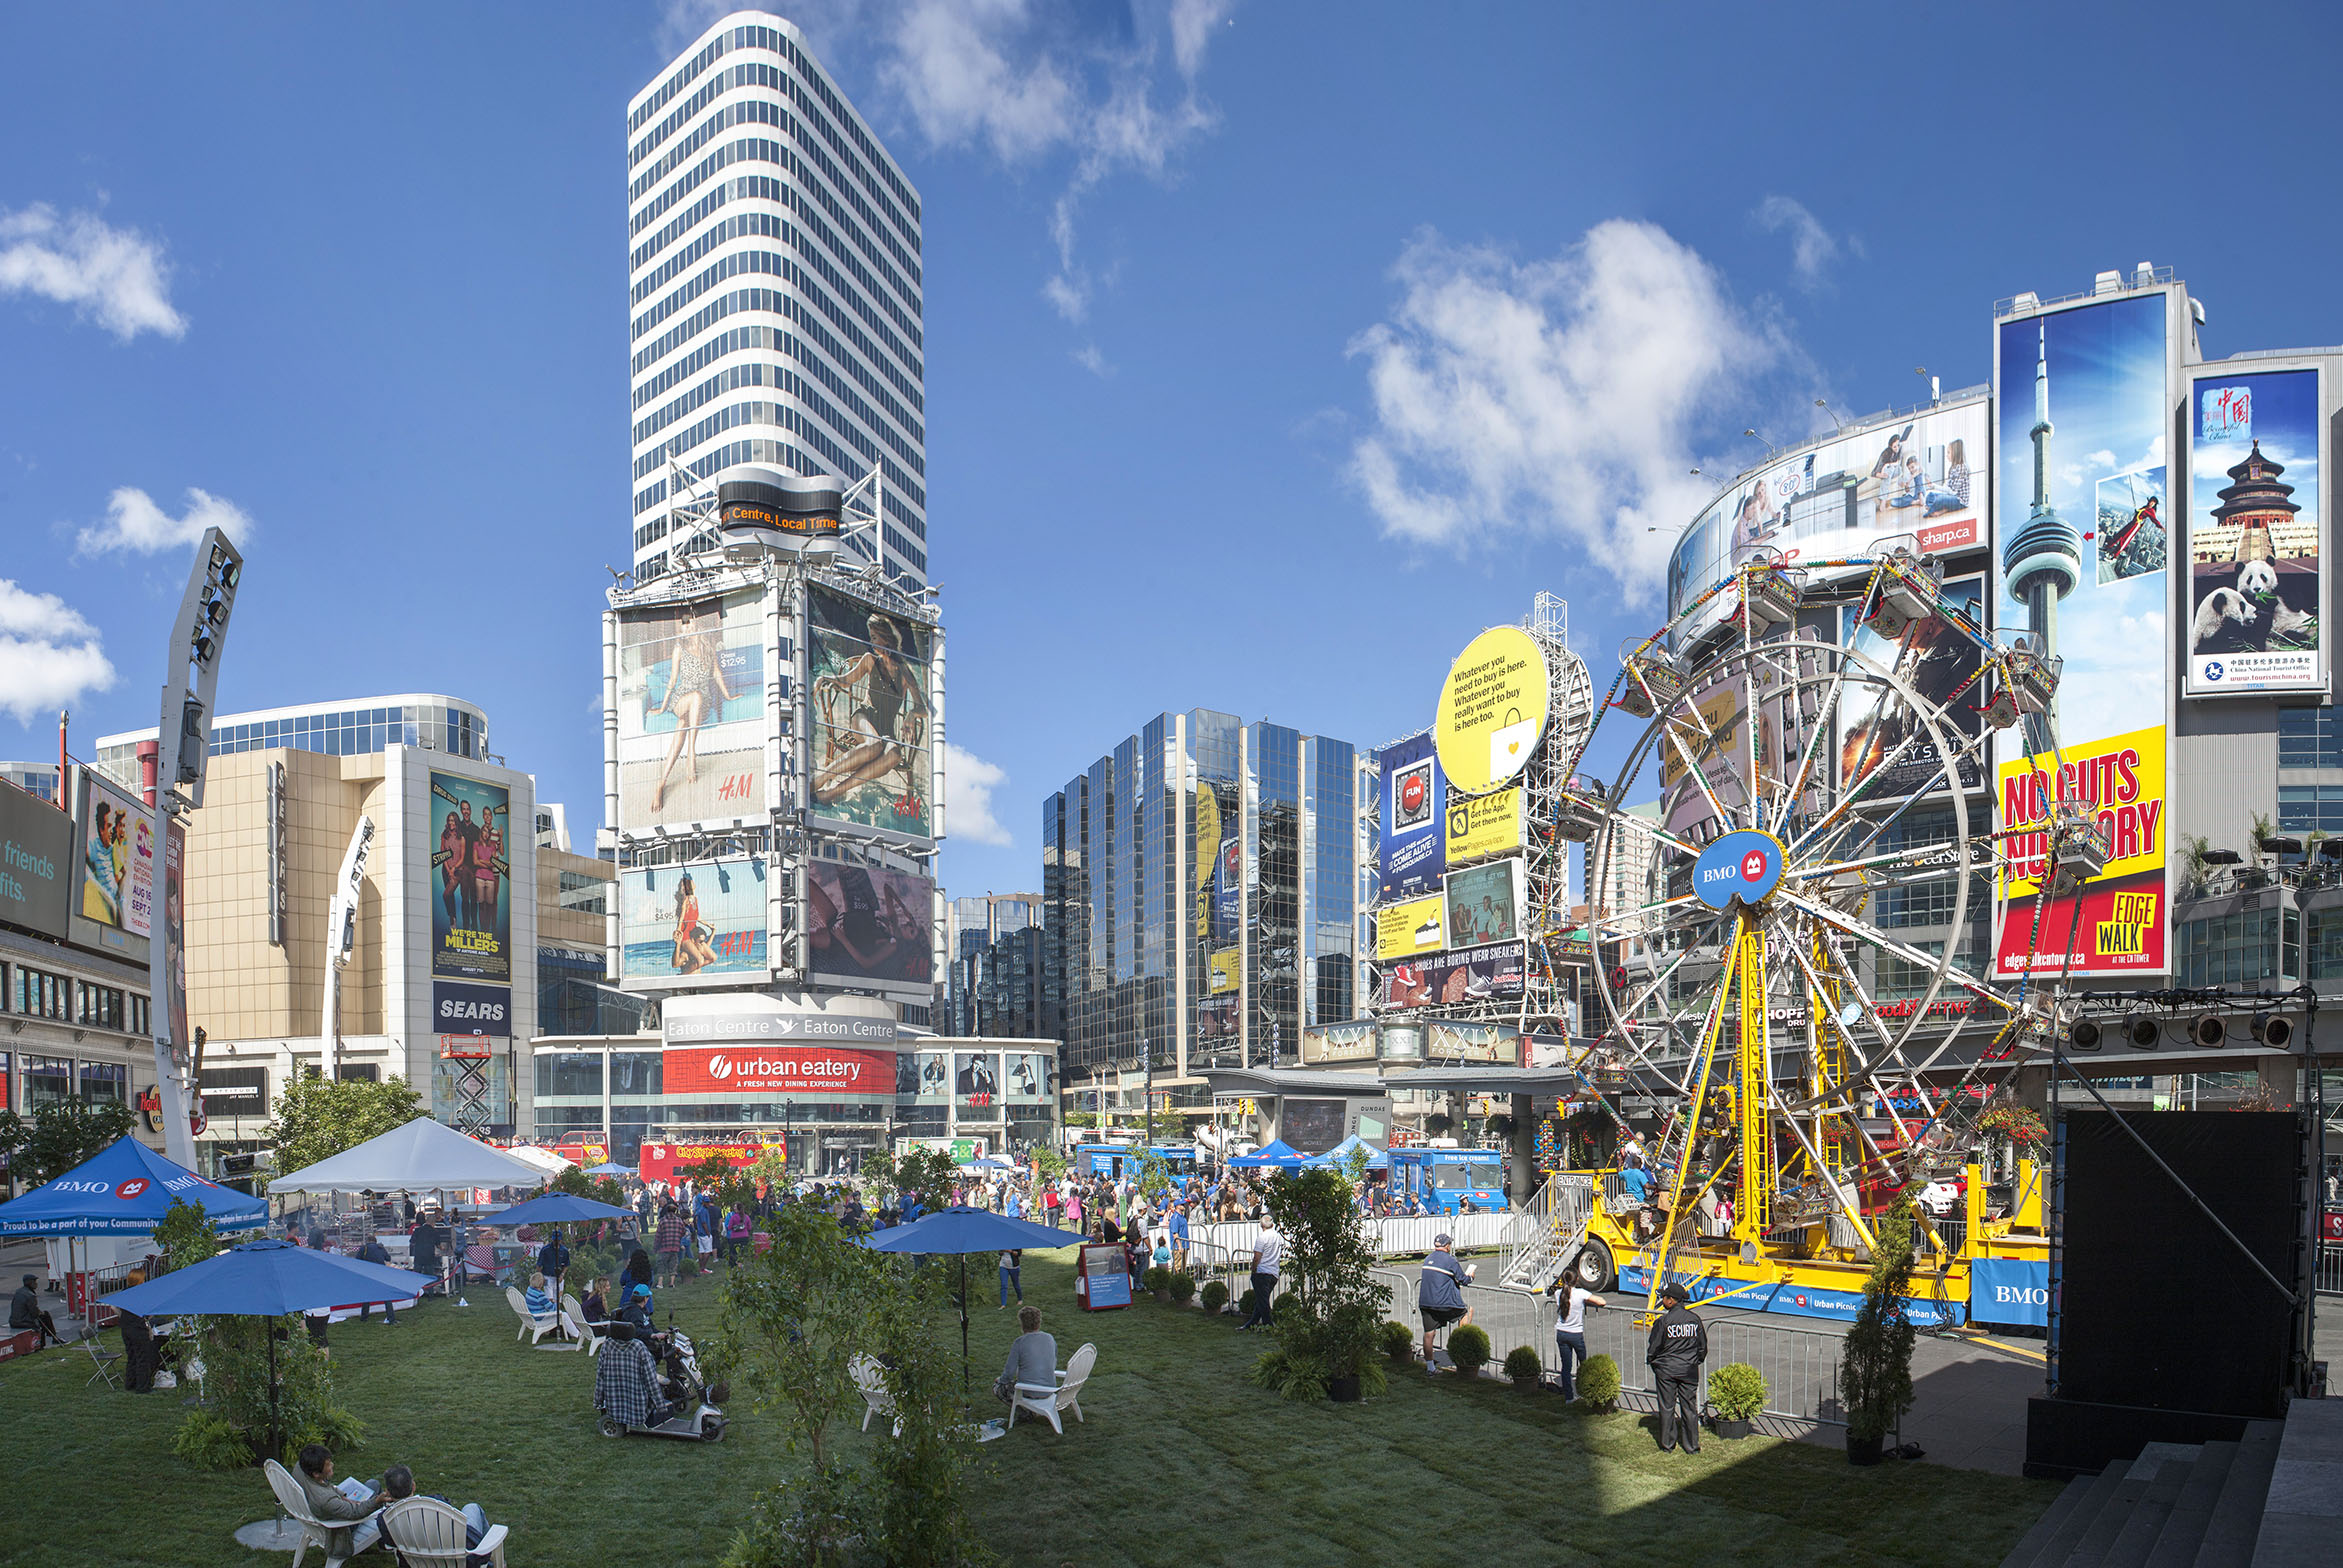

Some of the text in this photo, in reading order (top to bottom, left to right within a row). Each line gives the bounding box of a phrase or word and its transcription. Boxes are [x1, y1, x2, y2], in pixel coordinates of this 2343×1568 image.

[2218, 389, 2249, 429] 中国
[2203, 422, 2241, 434] Beautiful
[2209, 432, 2231, 440] China
[732, 508, 837, 530] Centre. Local Time
[1922, 525, 1970, 546] sharp.ca
[720, 656, 746, 668] $12.95
[1454, 656, 1505, 682] Whatever you
[1454, 660, 1527, 696] need to buy is here.
[1454, 681, 1505, 707] Whatever you
[1454, 688, 1520, 720] really want to buy
[1454, 711, 1494, 732] is here too.
[718, 772, 754, 800] H&M
[1406, 785, 1421, 798] FUN
[2005, 748, 2140, 828] NO GUTS
[894, 794, 921, 820] H&M
[1493, 804, 1506, 813] App.
[1482, 817, 1497, 826] there
[278, 768, 286, 911] SEARS
[4, 841, 55, 881] friends
[1392, 846, 1406, 859] MAKE
[1394, 840, 1432, 867] COME ALIVE
[1703, 865, 1736, 882] BMO
[132, 884, 145, 898] AUG
[132, 900, 147, 912] SEPT
[2116, 895, 2154, 924] EDGE
[451, 928, 492, 940] WE'RE THE
[2099, 923, 2139, 952] WALK
[445, 935, 498, 952] MILLERS
[720, 930, 755, 957] H&M
[1415, 944, 1523, 972] SHOES ARE BORING WEAR SNEAKERS
[2134, 954, 2150, 963] TOWER
[440, 1000, 504, 1021] SEARS
[668, 1020, 769, 1036] Eaton Centre
[804, 1020, 893, 1038] Eaton Centre
[1332, 1025, 1372, 1049] XXI
[1432, 1025, 1480, 1049] XXI
[1332, 1048, 1372, 1057] FOREVER
[736, 1057, 862, 1081] urban eatery
[968, 1092, 990, 1108] H&M
[53, 1182, 110, 1194] BMO
[162, 1174, 198, 1192] BMO
[3, 1221, 28, 1230] Proud
[28, 1222, 37, 1230] to
[38, 1220, 49, 1230] be
[58, 1220, 77, 1231] part
[79, 1218, 88, 1228] of
[89, 1219, 108, 1230] your
[111, 1218, 160, 1228] Community
[1731, 1292, 1749, 1300] Urban
[1751, 1292, 1770, 1301] Picnic
[1996, 1286, 2048, 1305] BMO
[1814, 1300, 1834, 1309] Urban
[1836, 1302, 1856, 1312] Picnic
[1907, 1305, 1929, 1318] Urban
[1667, 1324, 1699, 1338] SECURITY
